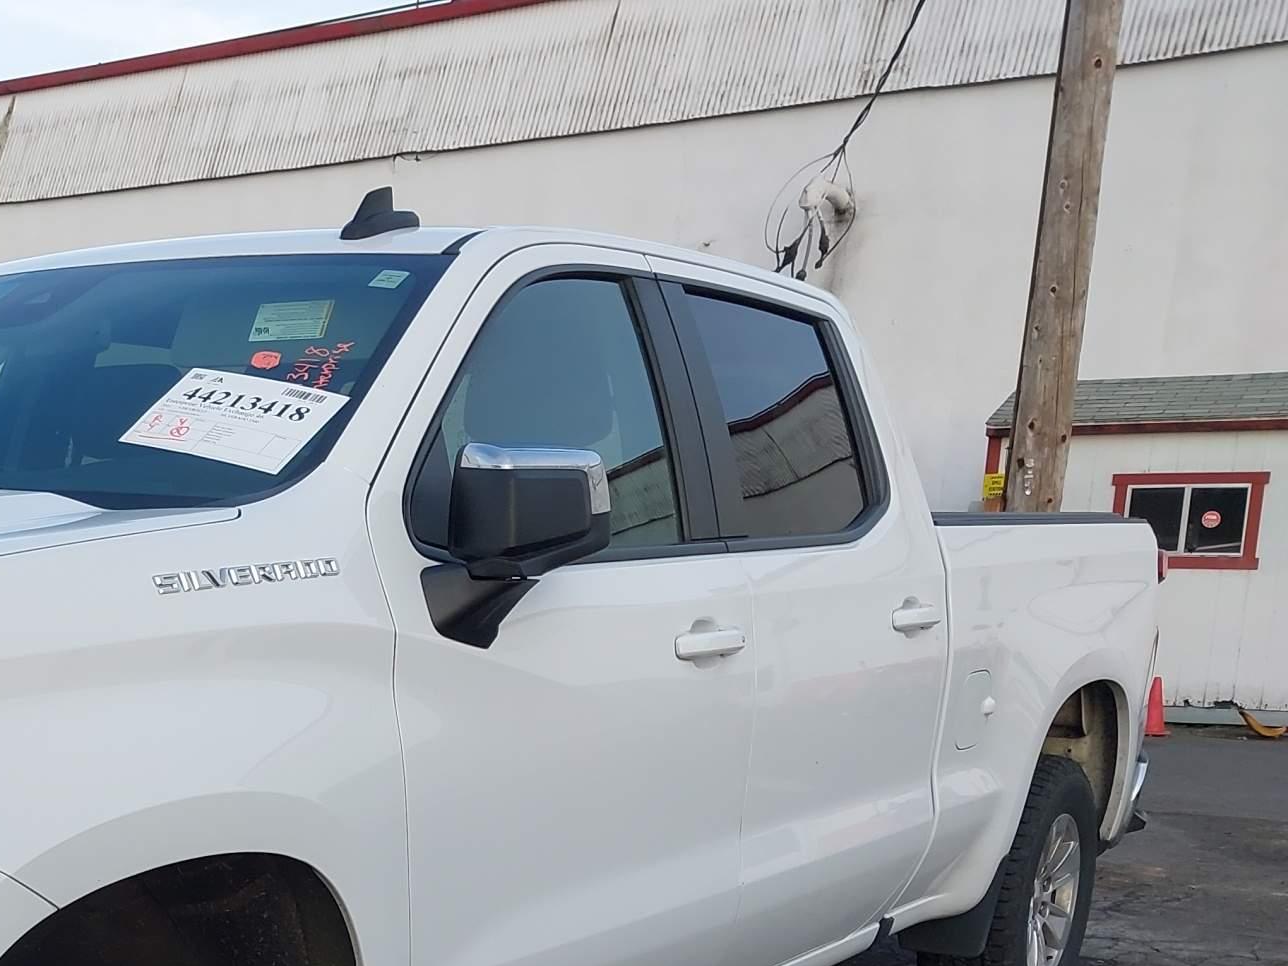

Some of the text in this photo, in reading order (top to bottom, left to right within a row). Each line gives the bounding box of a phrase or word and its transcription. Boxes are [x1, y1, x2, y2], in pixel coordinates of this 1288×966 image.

[286, 345, 330, 381] 3418
[182, 386, 311, 422] 44213418
[152, 557, 341, 594] SILVERADO
